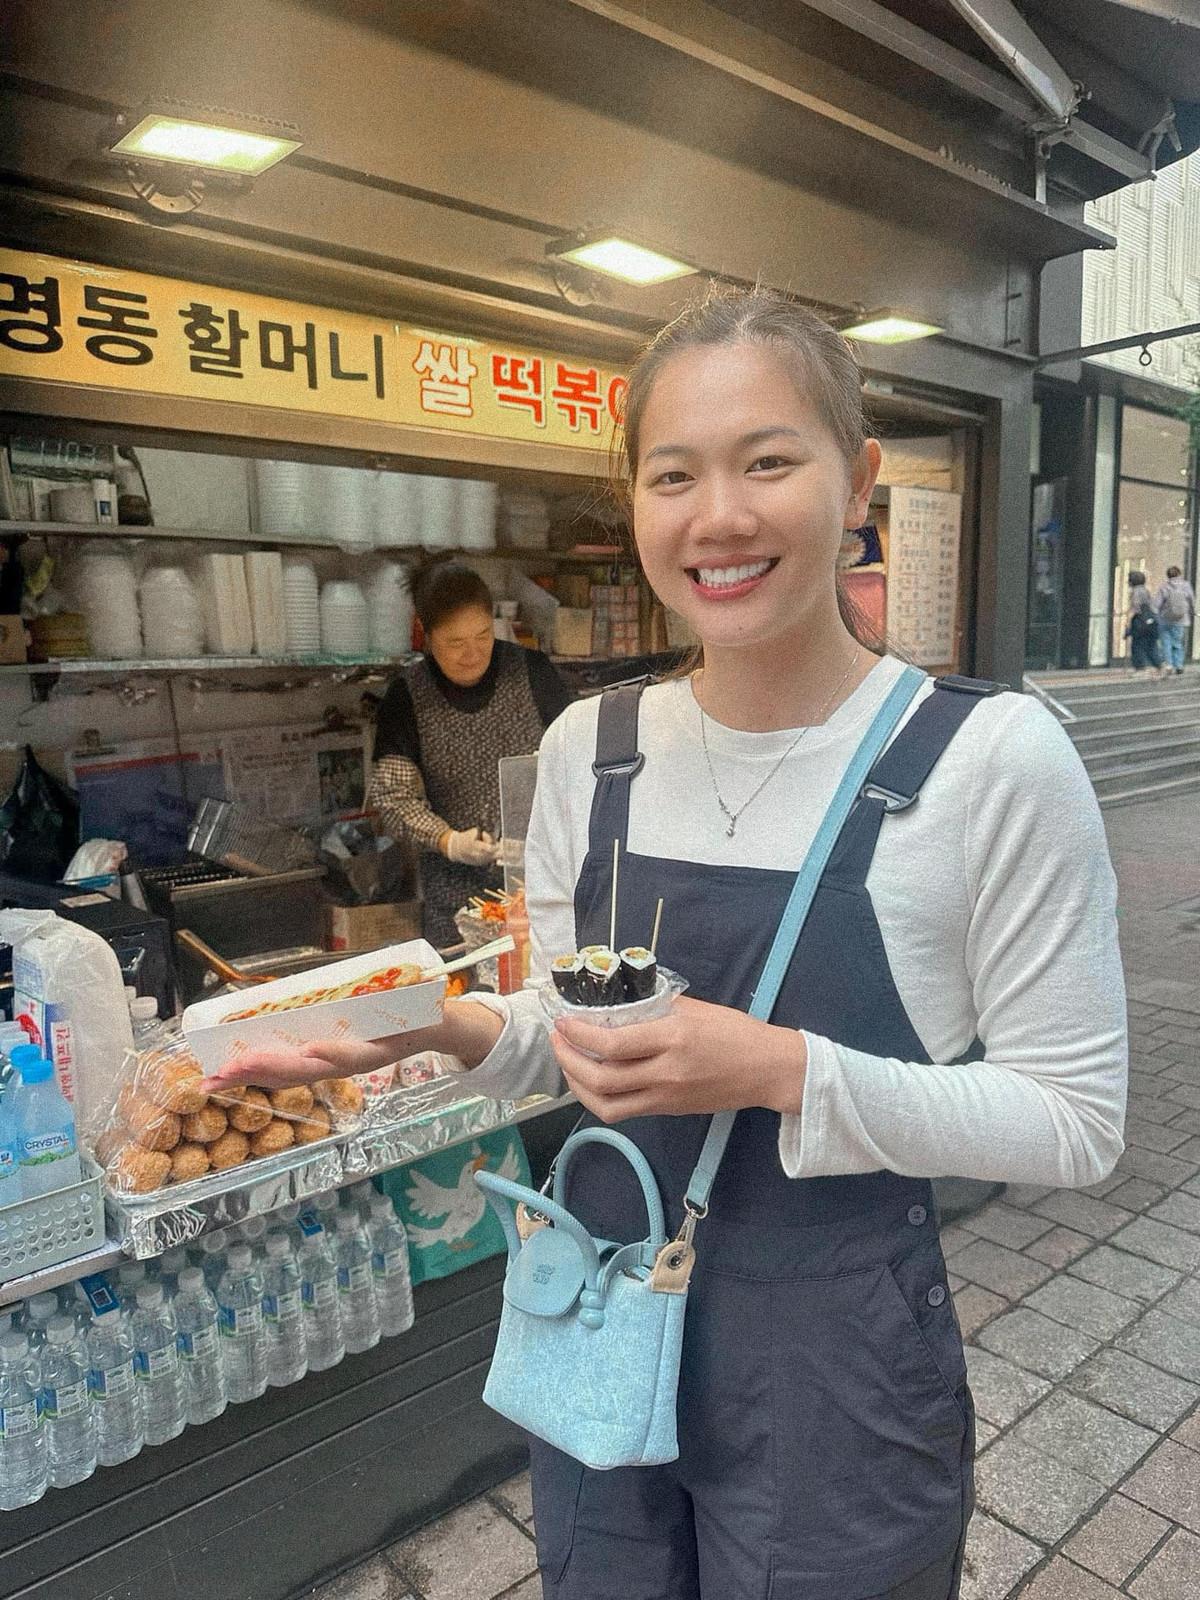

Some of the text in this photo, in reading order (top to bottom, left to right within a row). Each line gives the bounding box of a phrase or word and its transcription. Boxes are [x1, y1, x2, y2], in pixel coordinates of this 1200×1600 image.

[0, 272, 158, 365] 명동
[178, 302, 385, 399] 할머니
[25, 1134, 69, 1150] CRYSTAL
